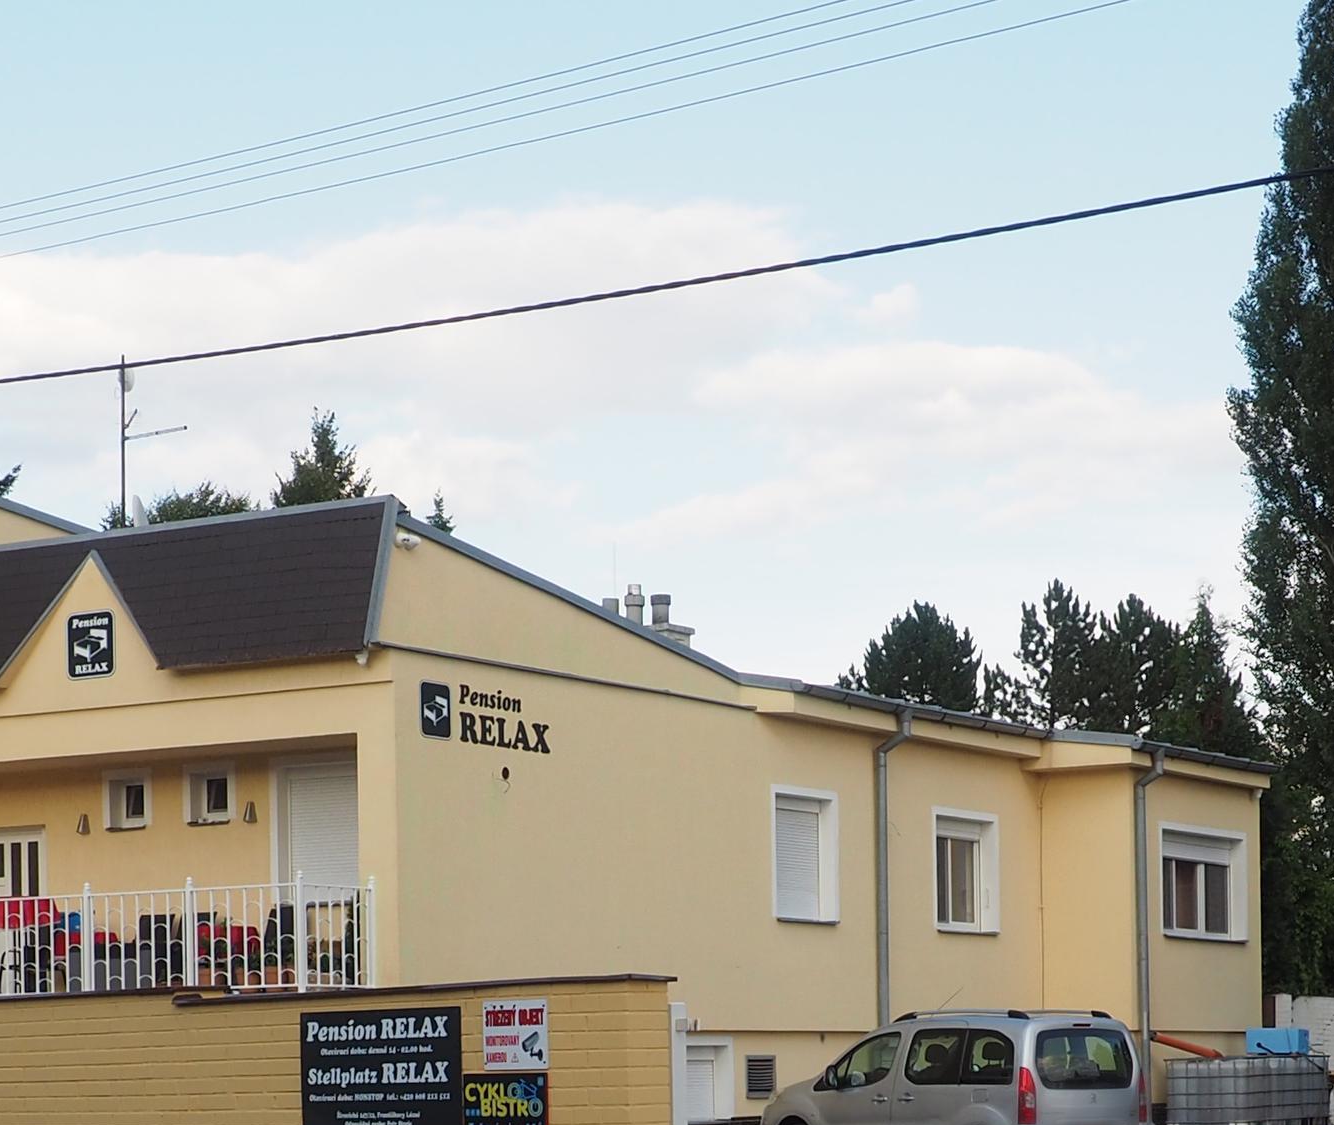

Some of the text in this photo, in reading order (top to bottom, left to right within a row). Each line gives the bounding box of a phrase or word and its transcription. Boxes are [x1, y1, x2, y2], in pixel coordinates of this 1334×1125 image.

[72, 617, 109, 629] Pension
[75, 662, 109, 675] RELAX
[459, 684, 522, 713] Pension
[459, 711, 551, 754] RELAX
[519, 1008, 544, 1026] OBJEKT
[306, 1016, 449, 1042] Pension RELAX
[307, 1061, 449, 1088] Stellplatz RELAX
[354, 1093, 384, 1101] NONSTOP
[465, 1082, 521, 1102] CYKLO
[480, 1098, 544, 1118] BISTRO
